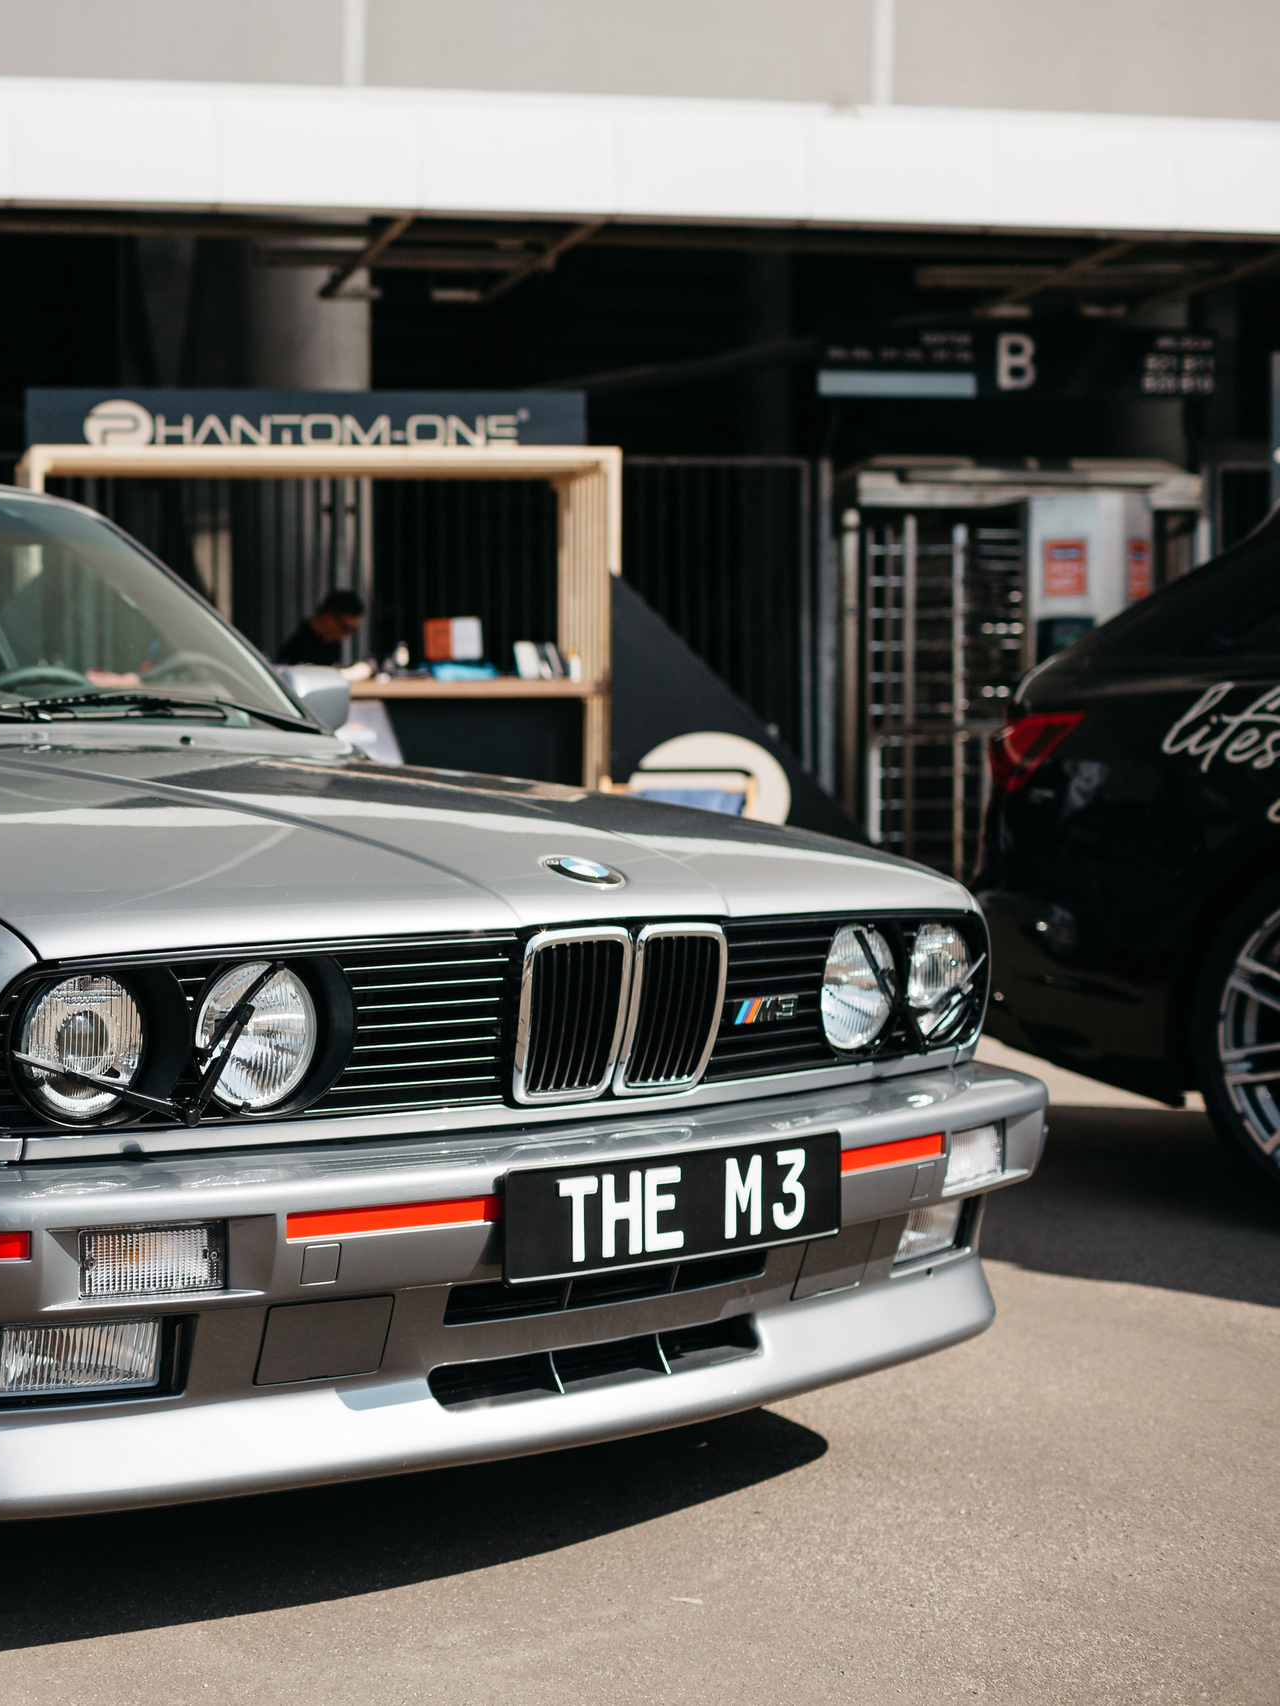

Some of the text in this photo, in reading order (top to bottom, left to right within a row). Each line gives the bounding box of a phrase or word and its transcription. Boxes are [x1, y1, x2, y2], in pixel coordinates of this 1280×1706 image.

[995, 332, 1037, 391] B
[558, 1147, 806, 1263] THE M3
